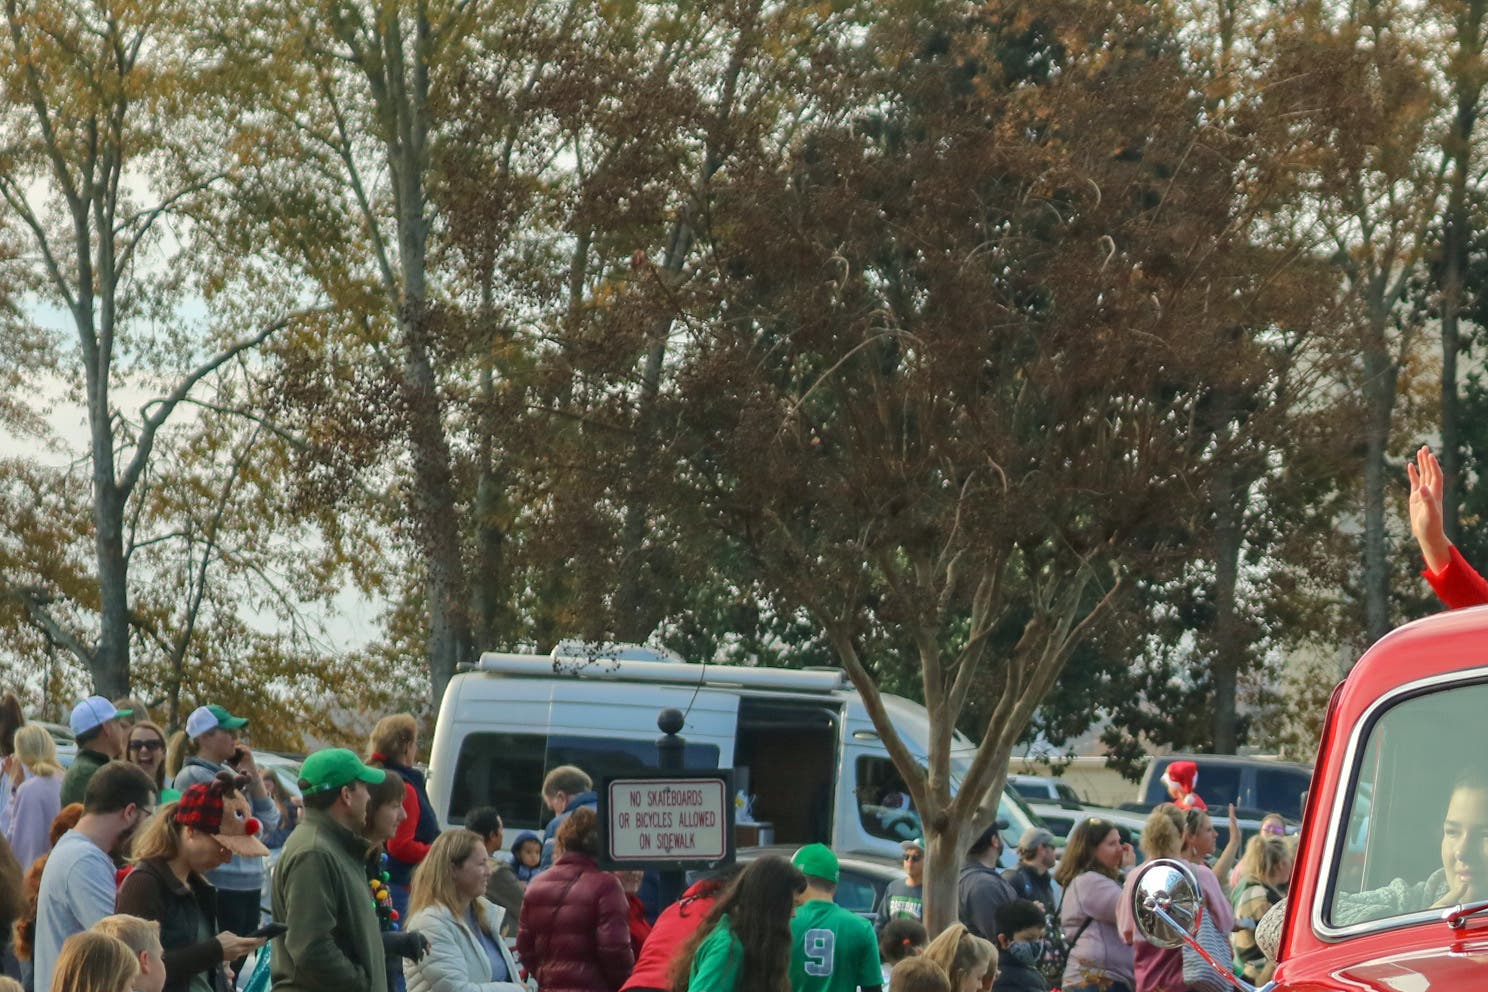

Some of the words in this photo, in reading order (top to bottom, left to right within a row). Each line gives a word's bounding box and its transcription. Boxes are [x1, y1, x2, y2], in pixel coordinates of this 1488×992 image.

[630, 790, 642, 807] NO
[648, 789, 703, 807] SKATEBOARDS
[619, 812, 630, 829] OR
[635, 812, 673, 829] BICYCLES
[678, 811, 716, 828] ALLOWED
[639, 833, 651, 850] ON
[656, 832, 696, 849] SIDEWALK
[804, 928, 835, 976] 9
